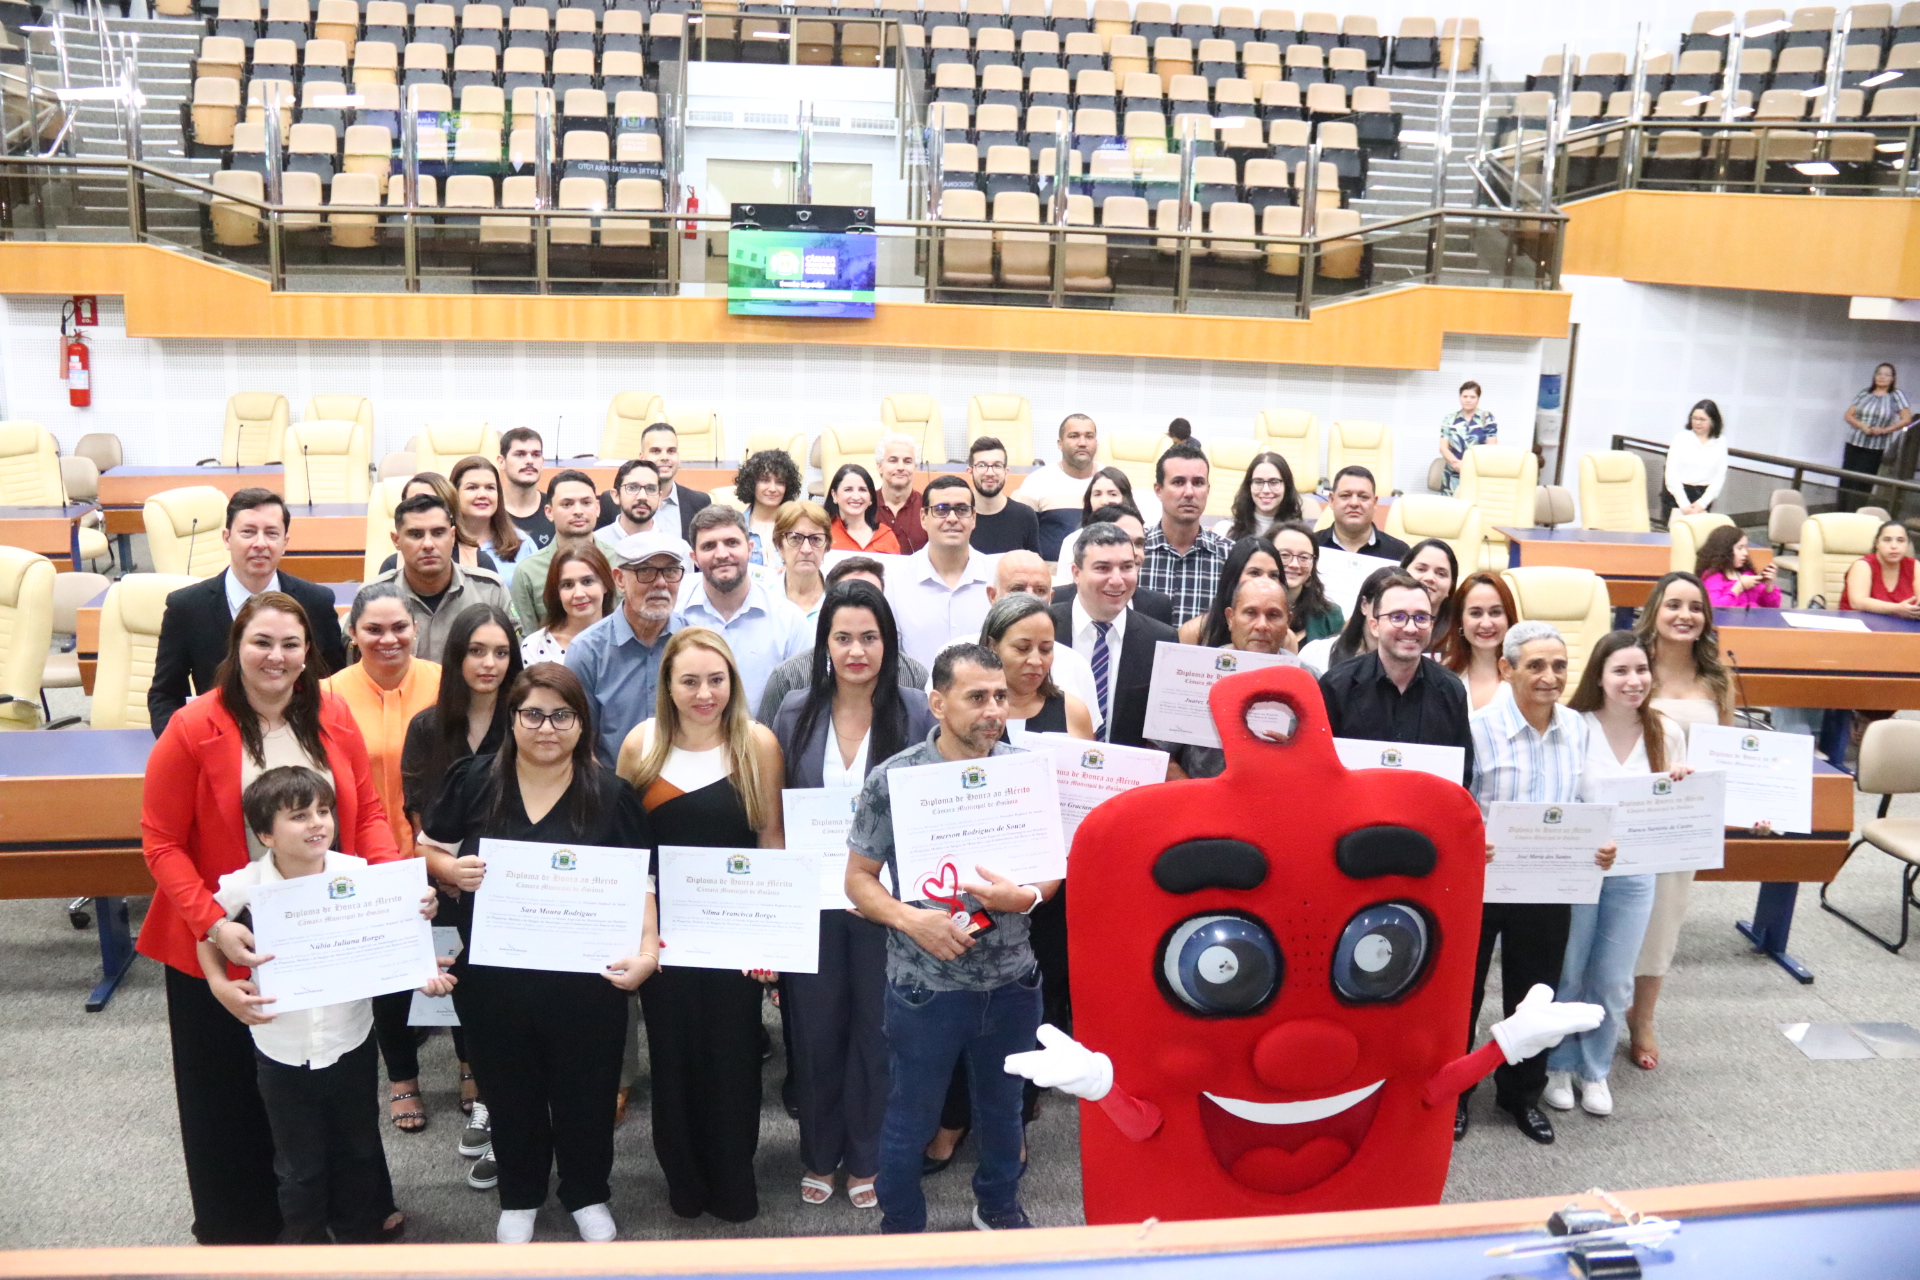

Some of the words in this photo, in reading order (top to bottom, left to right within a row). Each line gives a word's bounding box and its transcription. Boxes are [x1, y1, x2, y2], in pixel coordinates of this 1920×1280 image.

[1176, 669, 1204, 678] Diploma
[920, 797, 954, 807] Diploma
[956, 795, 963, 803] de
[967, 792, 990, 801] Honra
[1005, 786, 1030, 796] Mérito
[931, 833, 960, 841] Emerson
[962, 827, 995, 837] Rodrigues
[1006, 822, 1025, 830] Souza
[505, 870, 539, 881] Diploma
[542, 873, 549, 881] de
[686, 876, 717, 885] Diploma
[730, 878, 753, 887] Honra
[284, 906, 320, 919] Diploma
[323, 904, 331, 913] de
[364, 900, 372, 908] ao
[564, 909, 597, 918] Rodrigues
[722, 910, 753, 918] Francisca
[754, 911, 776, 919] Borges
[310, 942, 331, 951] Núbia
[332, 937, 359, 947] Juliana
[362, 933, 385, 944] Borges
